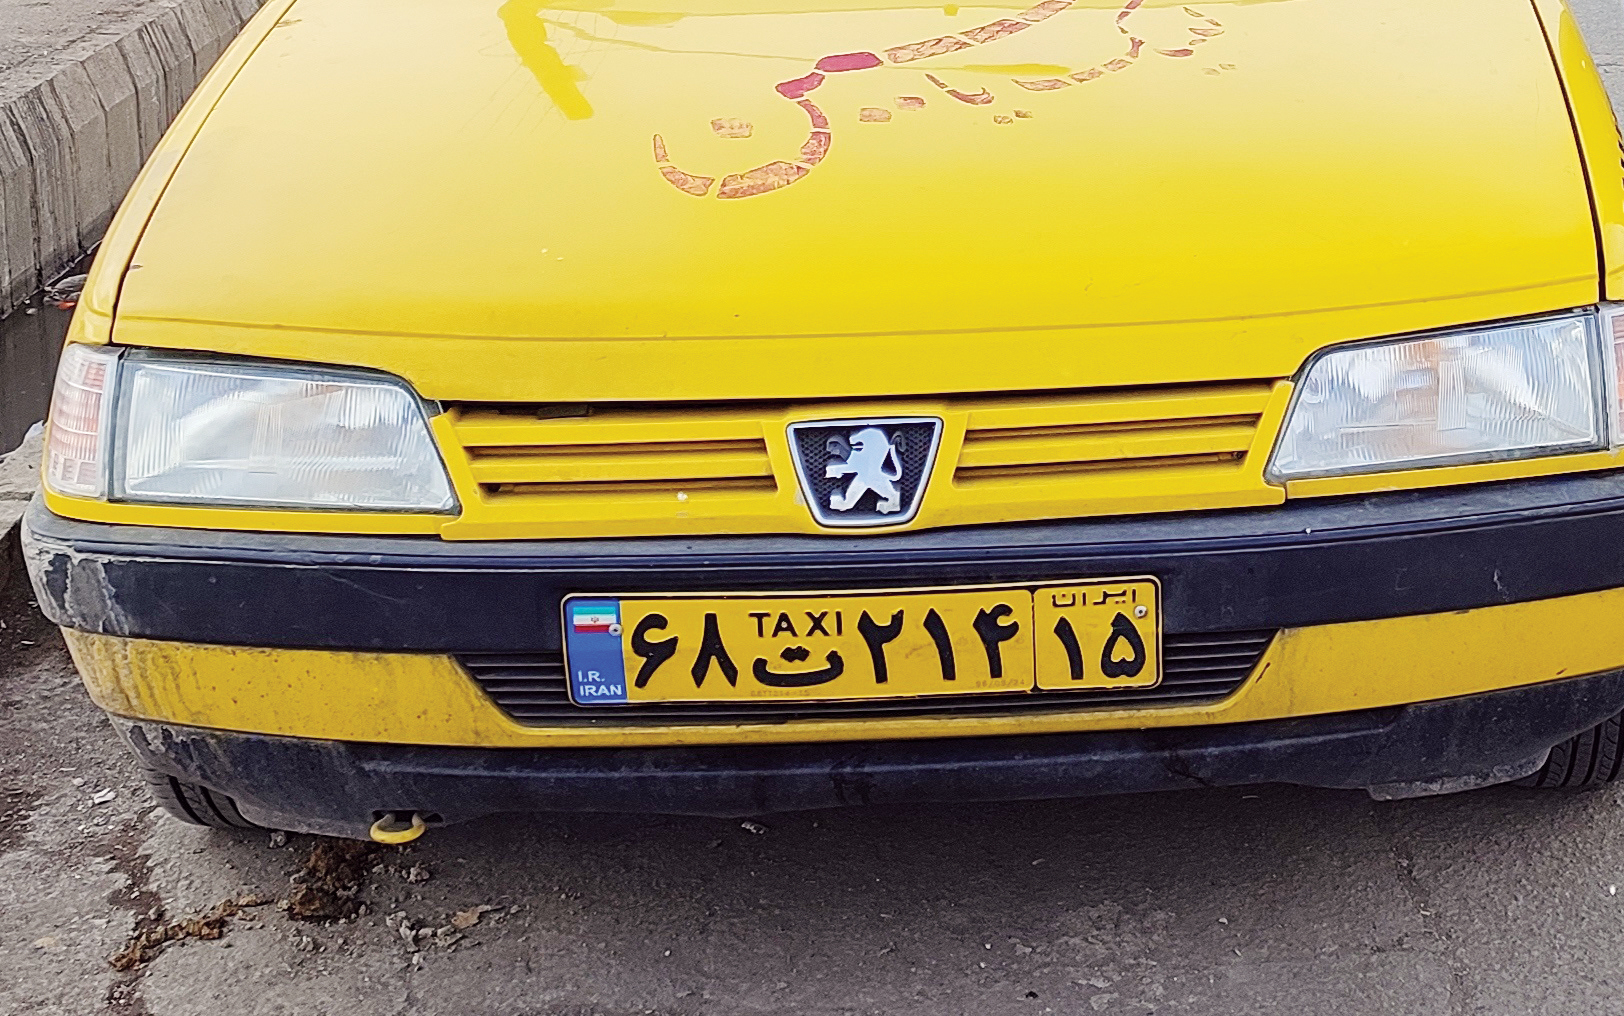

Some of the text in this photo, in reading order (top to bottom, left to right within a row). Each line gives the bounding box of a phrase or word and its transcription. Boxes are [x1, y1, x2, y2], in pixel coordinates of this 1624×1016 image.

[1051, 588, 1137, 608] ایران
[749, 611, 843, 638] TAXI
[1053, 613, 1146, 681] ۱۵
[578, 670, 605, 682] I.R.
[580, 684, 622, 696] IRAN
